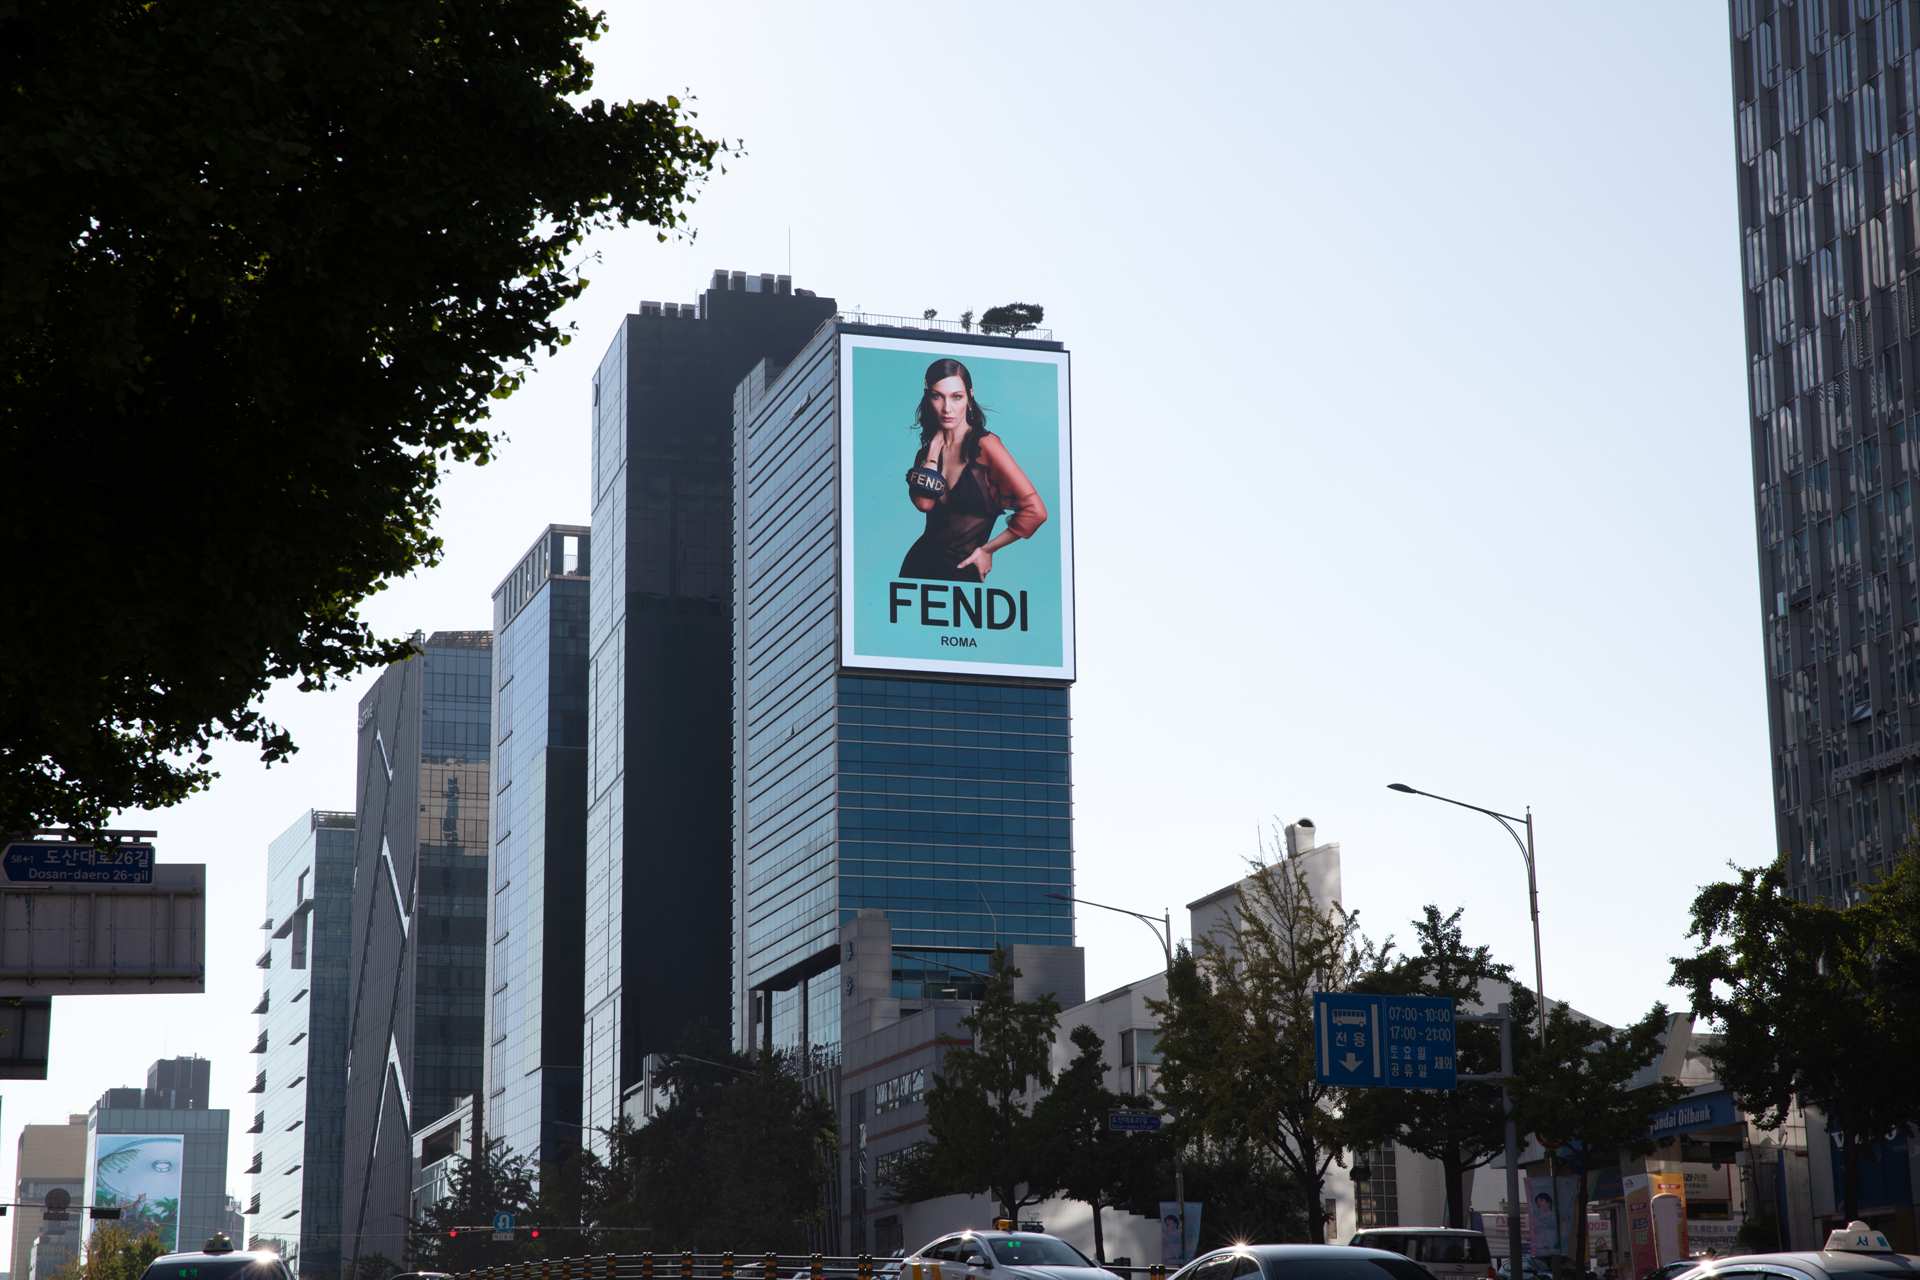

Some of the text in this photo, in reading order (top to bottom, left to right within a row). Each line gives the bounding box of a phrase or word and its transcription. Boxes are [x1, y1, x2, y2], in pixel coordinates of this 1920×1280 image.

[889, 581, 1029, 632] FENDI
[940, 635, 978, 649] ROMA
[28, 867, 149, 882] Dosan-daero 26-gil
[1678, 1103, 1711, 1126] Oilbank
